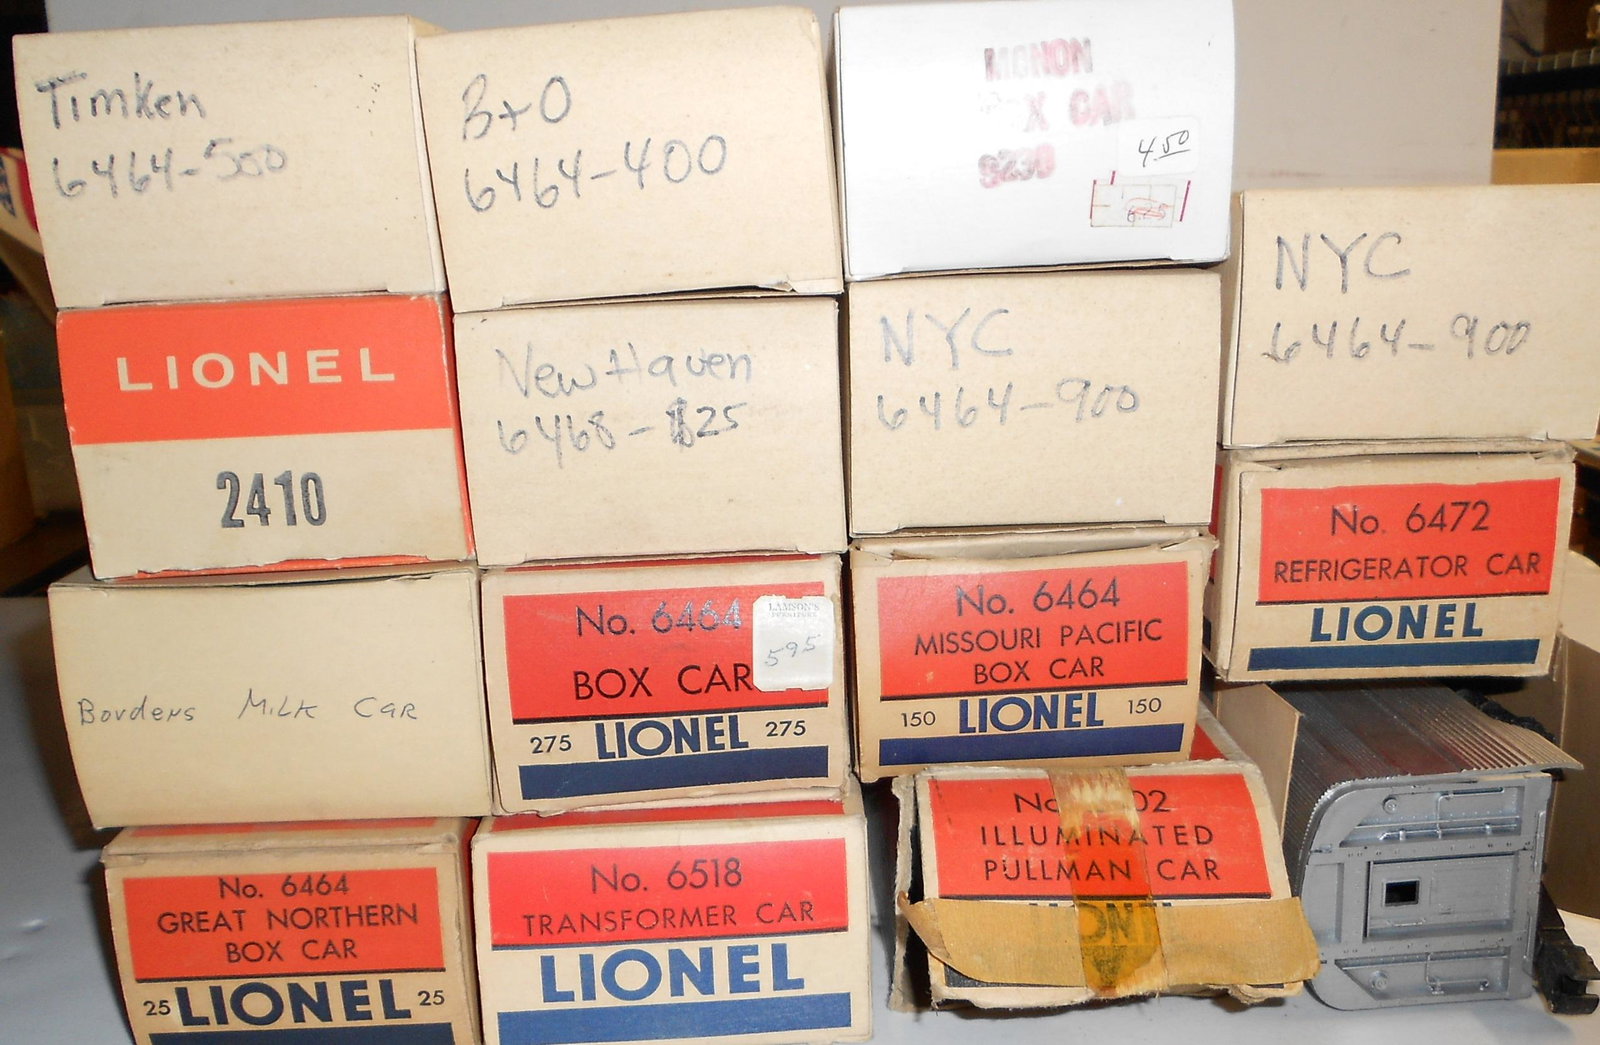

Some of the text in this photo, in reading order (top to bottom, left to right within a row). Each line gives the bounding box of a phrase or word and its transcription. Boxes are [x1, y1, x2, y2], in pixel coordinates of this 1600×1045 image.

[53, 137, 288, 198] 6464-500
[464, 134, 727, 212] 6464-400
[1275, 232, 1411, 293] NYC
[880, 307, 1013, 370] NYC
[1261, 313, 1531, 364] 6464-900
[116, 347, 395, 392] LIONEL
[877, 377, 1141, 430] 6464-900
[216, 470, 327, 528] 2410
[1330, 500, 1491, 536] No. 6472
[1273, 552, 1541, 584] REFRIGERATOR CAR
[955, 576, 1120, 617] No. 6464
[575, 597, 742, 637] No. 6464
[1310, 602, 1483, 642] LIONEL
[914, 618, 1163, 656] MISSOURI PACIFIC
[573, 662, 753, 701] BOX CAR
[974, 655, 1105, 685] BOX CAR
[901, 710, 936, 728] 150
[958, 692, 1104, 734] LIONEL
[1128, 697, 1162, 714] 150
[529, 734, 573, 754] 275
[595, 714, 749, 760] LIONEL
[765, 720, 807, 737] 275
[1014, 791, 1060, 815] No
[981, 825, 1214, 847] ILLUMINATED
[218, 873, 349, 899] No. 6464
[591, 857, 743, 894] No. 6518
[985, 858, 1222, 882] PULLMAN CAR
[157, 903, 418, 935] GREAT NORTHERN
[523, 901, 815, 937] TRANSFORMER CAR
[226, 938, 358, 963] BOX CAR
[540, 942, 805, 1003] LIONEL
[143, 1000, 171, 1016] 25
[175, 978, 412, 1027] LIONEL
[417, 989, 445, 1006] 25
